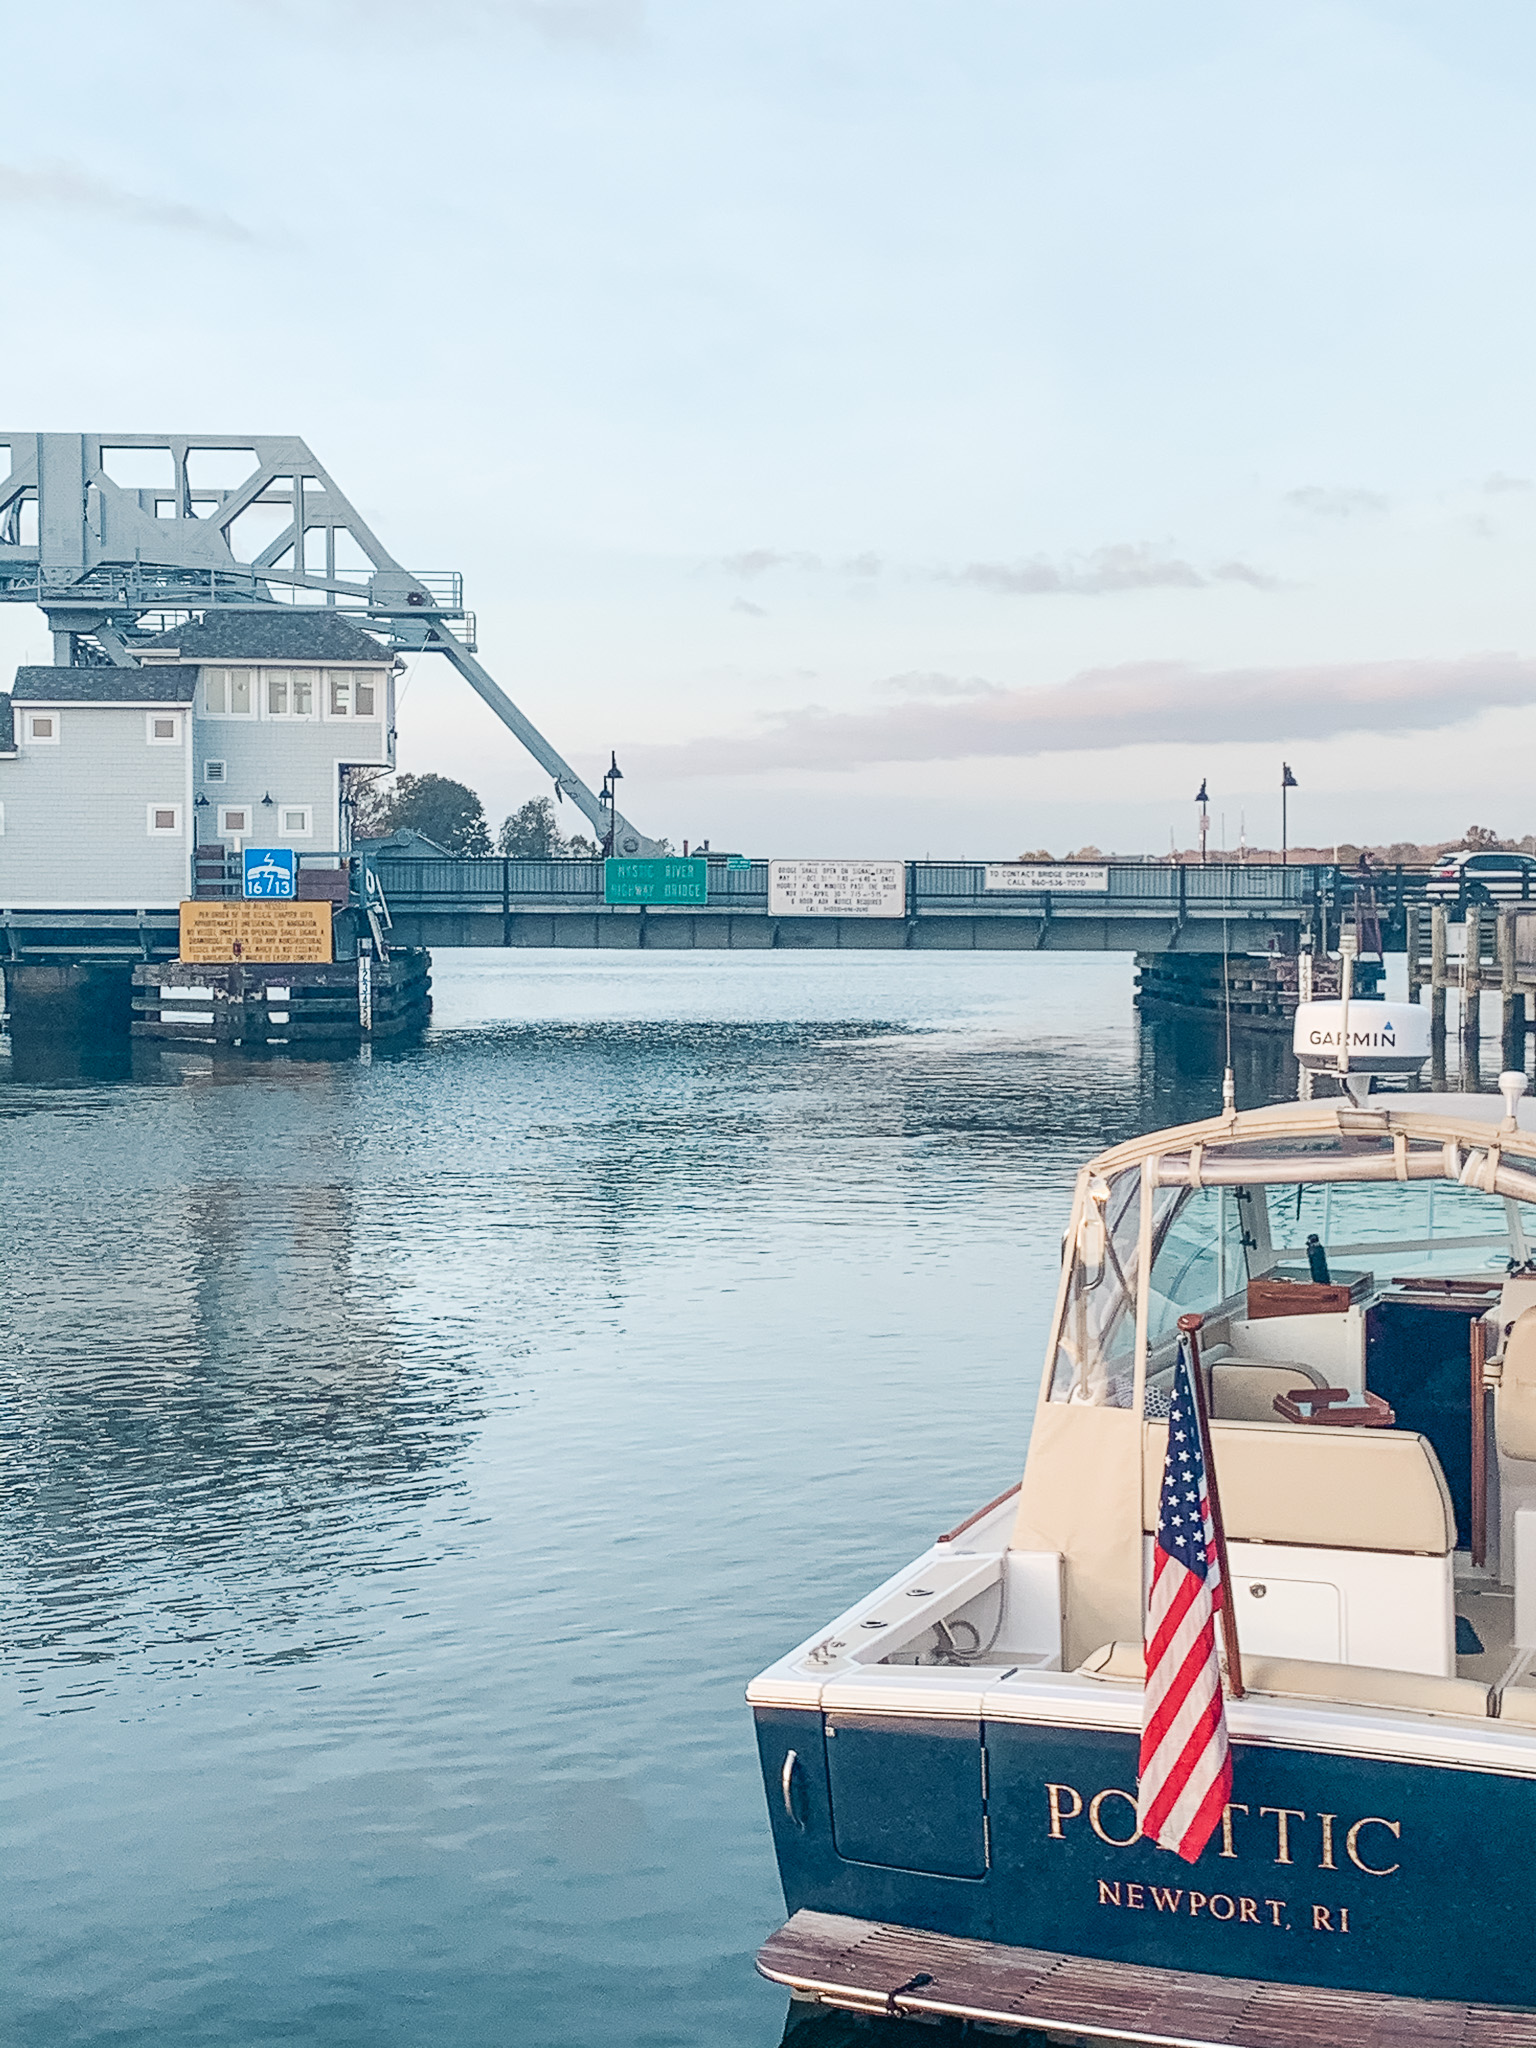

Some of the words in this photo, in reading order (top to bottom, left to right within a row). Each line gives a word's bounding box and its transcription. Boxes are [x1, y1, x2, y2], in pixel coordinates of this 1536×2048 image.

[665, 865, 694, 878] RIVER
[248, 881, 262, 894] 16
[275, 881, 290, 894] 13
[611, 884, 655, 897] HIGHWAY
[664, 884, 700, 897] BRIDGE
[1310, 1031, 1396, 1047] GARMIN
[1044, 1783, 1401, 1876] POTTIC
[1098, 1880, 1292, 1931] NEWPORT,
[1312, 1904, 1350, 1933] RI
